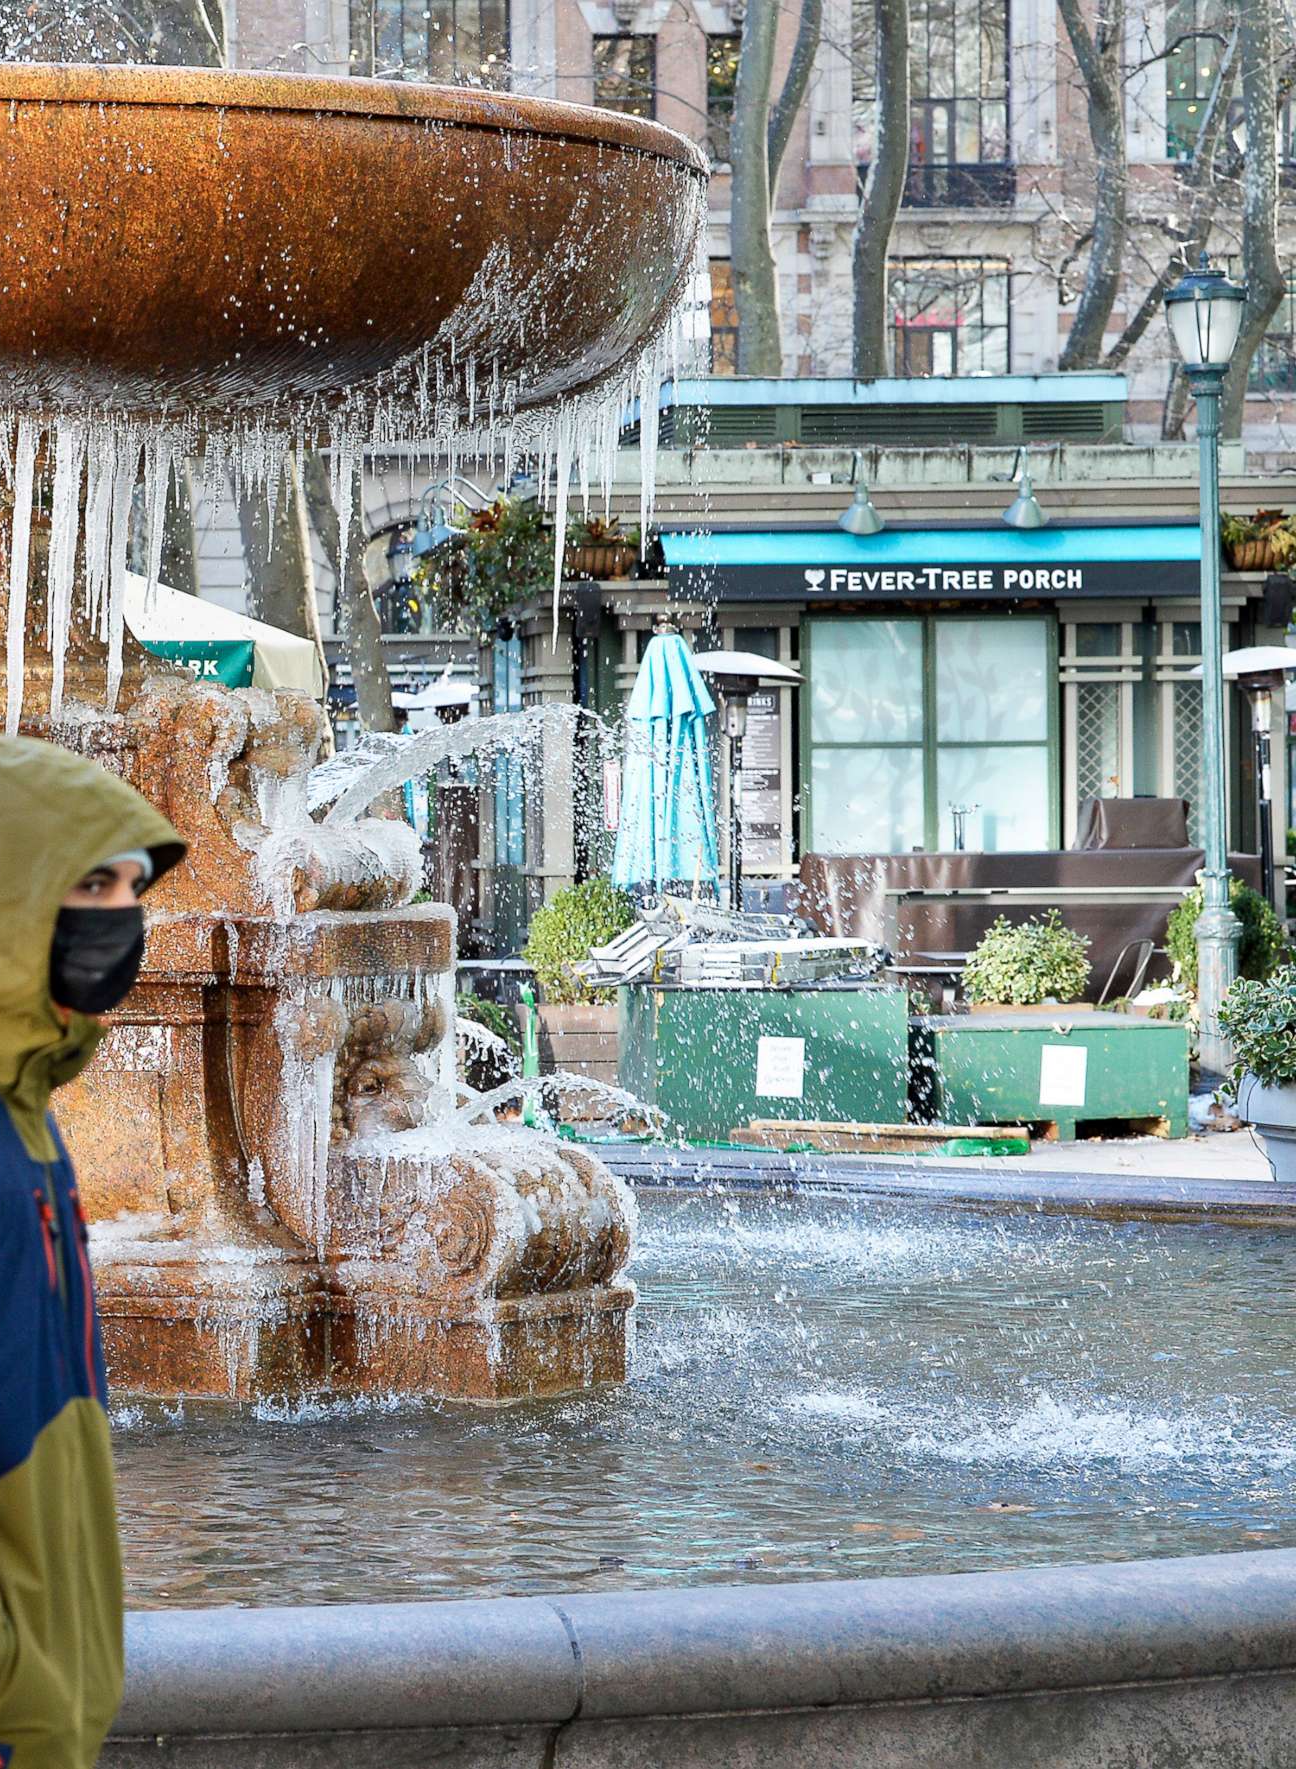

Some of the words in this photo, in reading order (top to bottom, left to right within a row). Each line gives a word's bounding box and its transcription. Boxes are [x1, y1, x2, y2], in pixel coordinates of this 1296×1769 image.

[830, 568, 994, 592] FEVER-TREE
[1003, 569, 1083, 590] PORCH
[166, 658, 220, 677] ARK
[747, 696, 773, 707] RINKS
